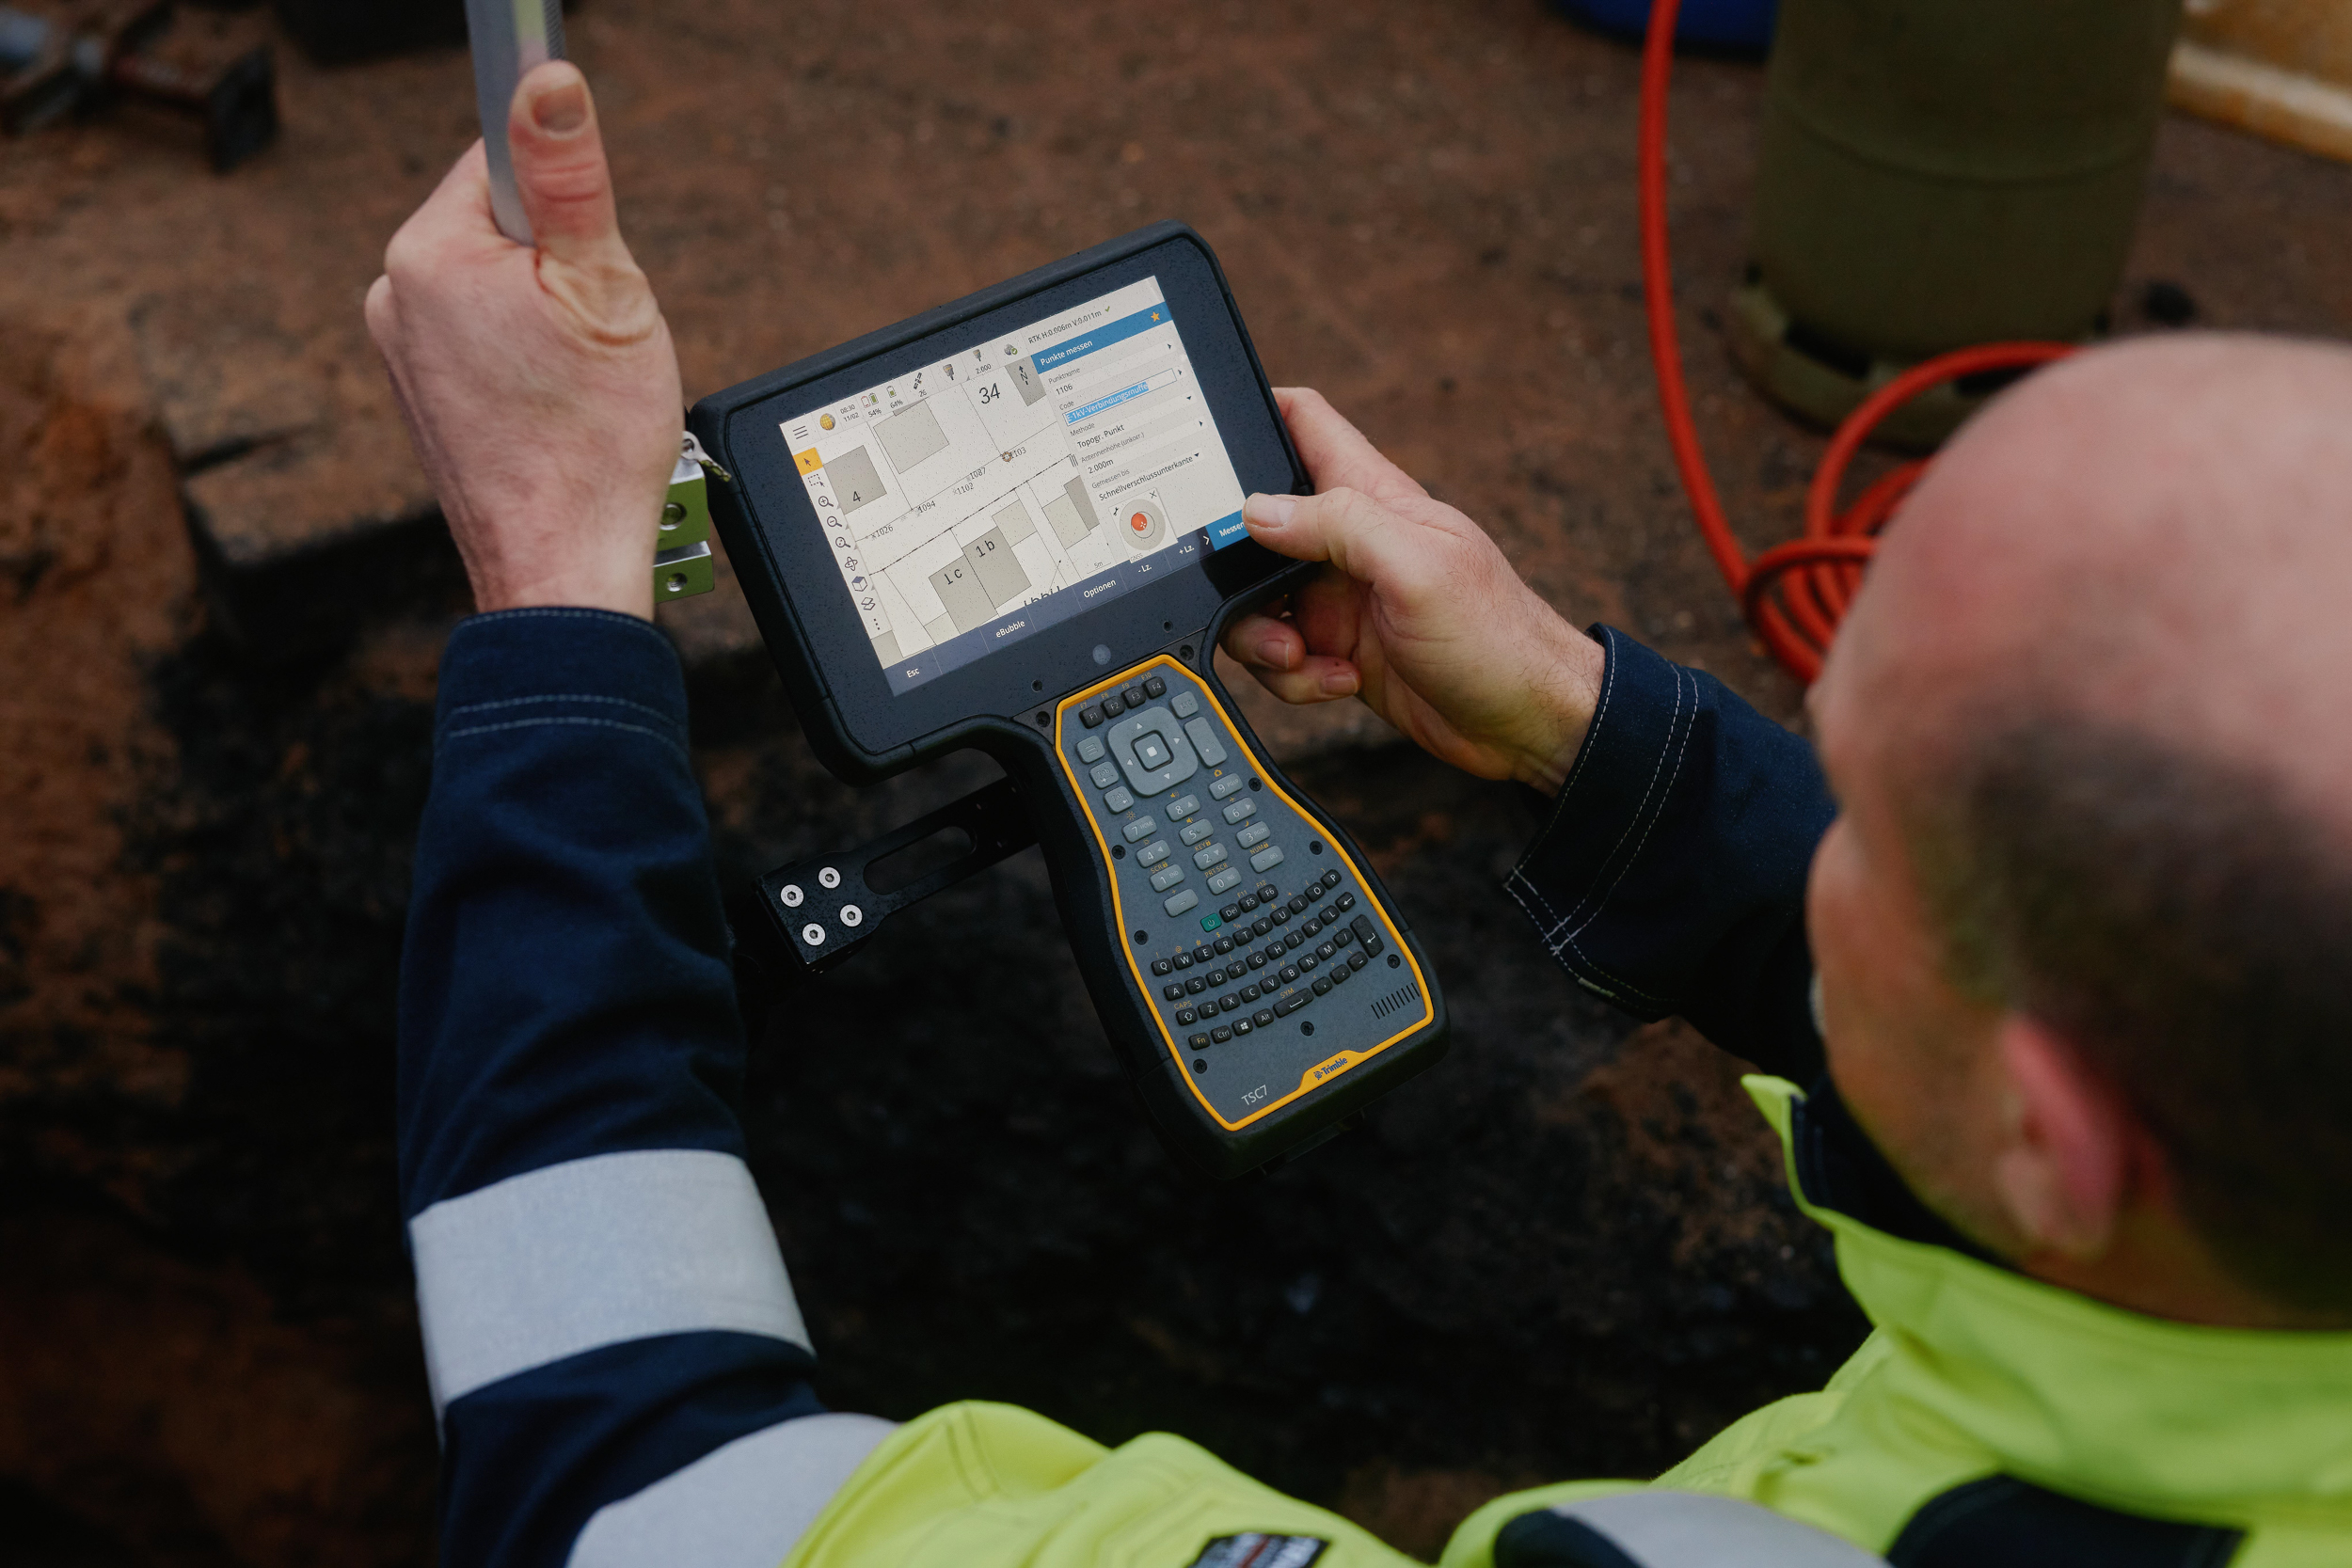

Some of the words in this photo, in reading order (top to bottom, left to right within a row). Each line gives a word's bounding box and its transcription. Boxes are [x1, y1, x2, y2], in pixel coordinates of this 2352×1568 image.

[1028, 335, 1041, 344] RTK
[1040, 350, 1066, 366] Punkte
[1066, 340, 1093, 357] messen
[1048, 367, 1081, 384] Punktname
[978, 382, 1001, 404] 34
[1056, 383, 1073, 396] 1106
[1059, 400, 1074, 411] Code
[843, 412, 860, 422] 11/02
[868, 407, 882, 418] 54%
[1070, 423, 1095, 437] Methode
[1077, 434, 1104, 448] Topogr.
[1104, 424, 1125, 437] Punkt
[1088, 459, 1114, 474] 2.000m
[1091, 474, 1120, 489] Gemessen
[1120, 468, 1130, 479] bis
[1099, 455, 1194, 501] Schnellverschlussunterkante
[852, 491, 862, 502] 4
[1094, 561, 1103, 569] 5m
[1084, 579, 1117, 598] Optionen
[995, 619, 1025, 639] eBubble
[906, 667, 920, 678] Esc
[1152, 682, 1162, 691] F4
[1131, 692, 1141, 701] F3
[1110, 702, 1120, 710] F2
[1089, 713, 1099, 721] F1
[1217, 784, 1226, 793] 9
[1175, 805, 1184, 815] 8
[1232, 808, 1240, 817] 6
[1131, 826, 1138, 836] 7
[1188, 830, 1197, 840] 5
[1246, 832, 1254, 842] 3
[1195, 842, 1207, 851] KEY
[1249, 845, 1263, 854] NUM
[1147, 850, 1154, 861] 4
[1203, 853, 1212, 863] 2
[1150, 863, 1163, 874] SCR
[1160, 876, 1168, 885] 1
[1329, 874, 1336, 882] P
[1216, 879, 1225, 888] 0
[1256, 879, 1266, 889] F12
[1237, 890, 1248, 898] F11
[1265, 888, 1274, 896] F6
[1247, 897, 1255, 907] F5
[1226, 907, 1238, 917] Del
[1311, 923, 1318, 931] K
[1295, 935, 1300, 943] J
[1274, 945, 1282, 954] H
[1324, 944, 1333, 954] M
[1180, 956, 1189, 964] W
[1306, 958, 1314, 966] N
[1159, 962, 1168, 971] Q
[1279, 987, 1295, 999] SYM
[1173, 1000, 1193, 1010] CAPS
[1228, 997, 1235, 1006] X
[1207, 1005, 1214, 1013] Z
[1261, 1013, 1270, 1022] Alt
[1217, 1029, 1231, 1038] Ctrl
[1197, 1037, 1206, 1045] Fn
[1321, 1057, 1348, 1075] Trimble
[1241, 1084, 1267, 1106] TSC7
